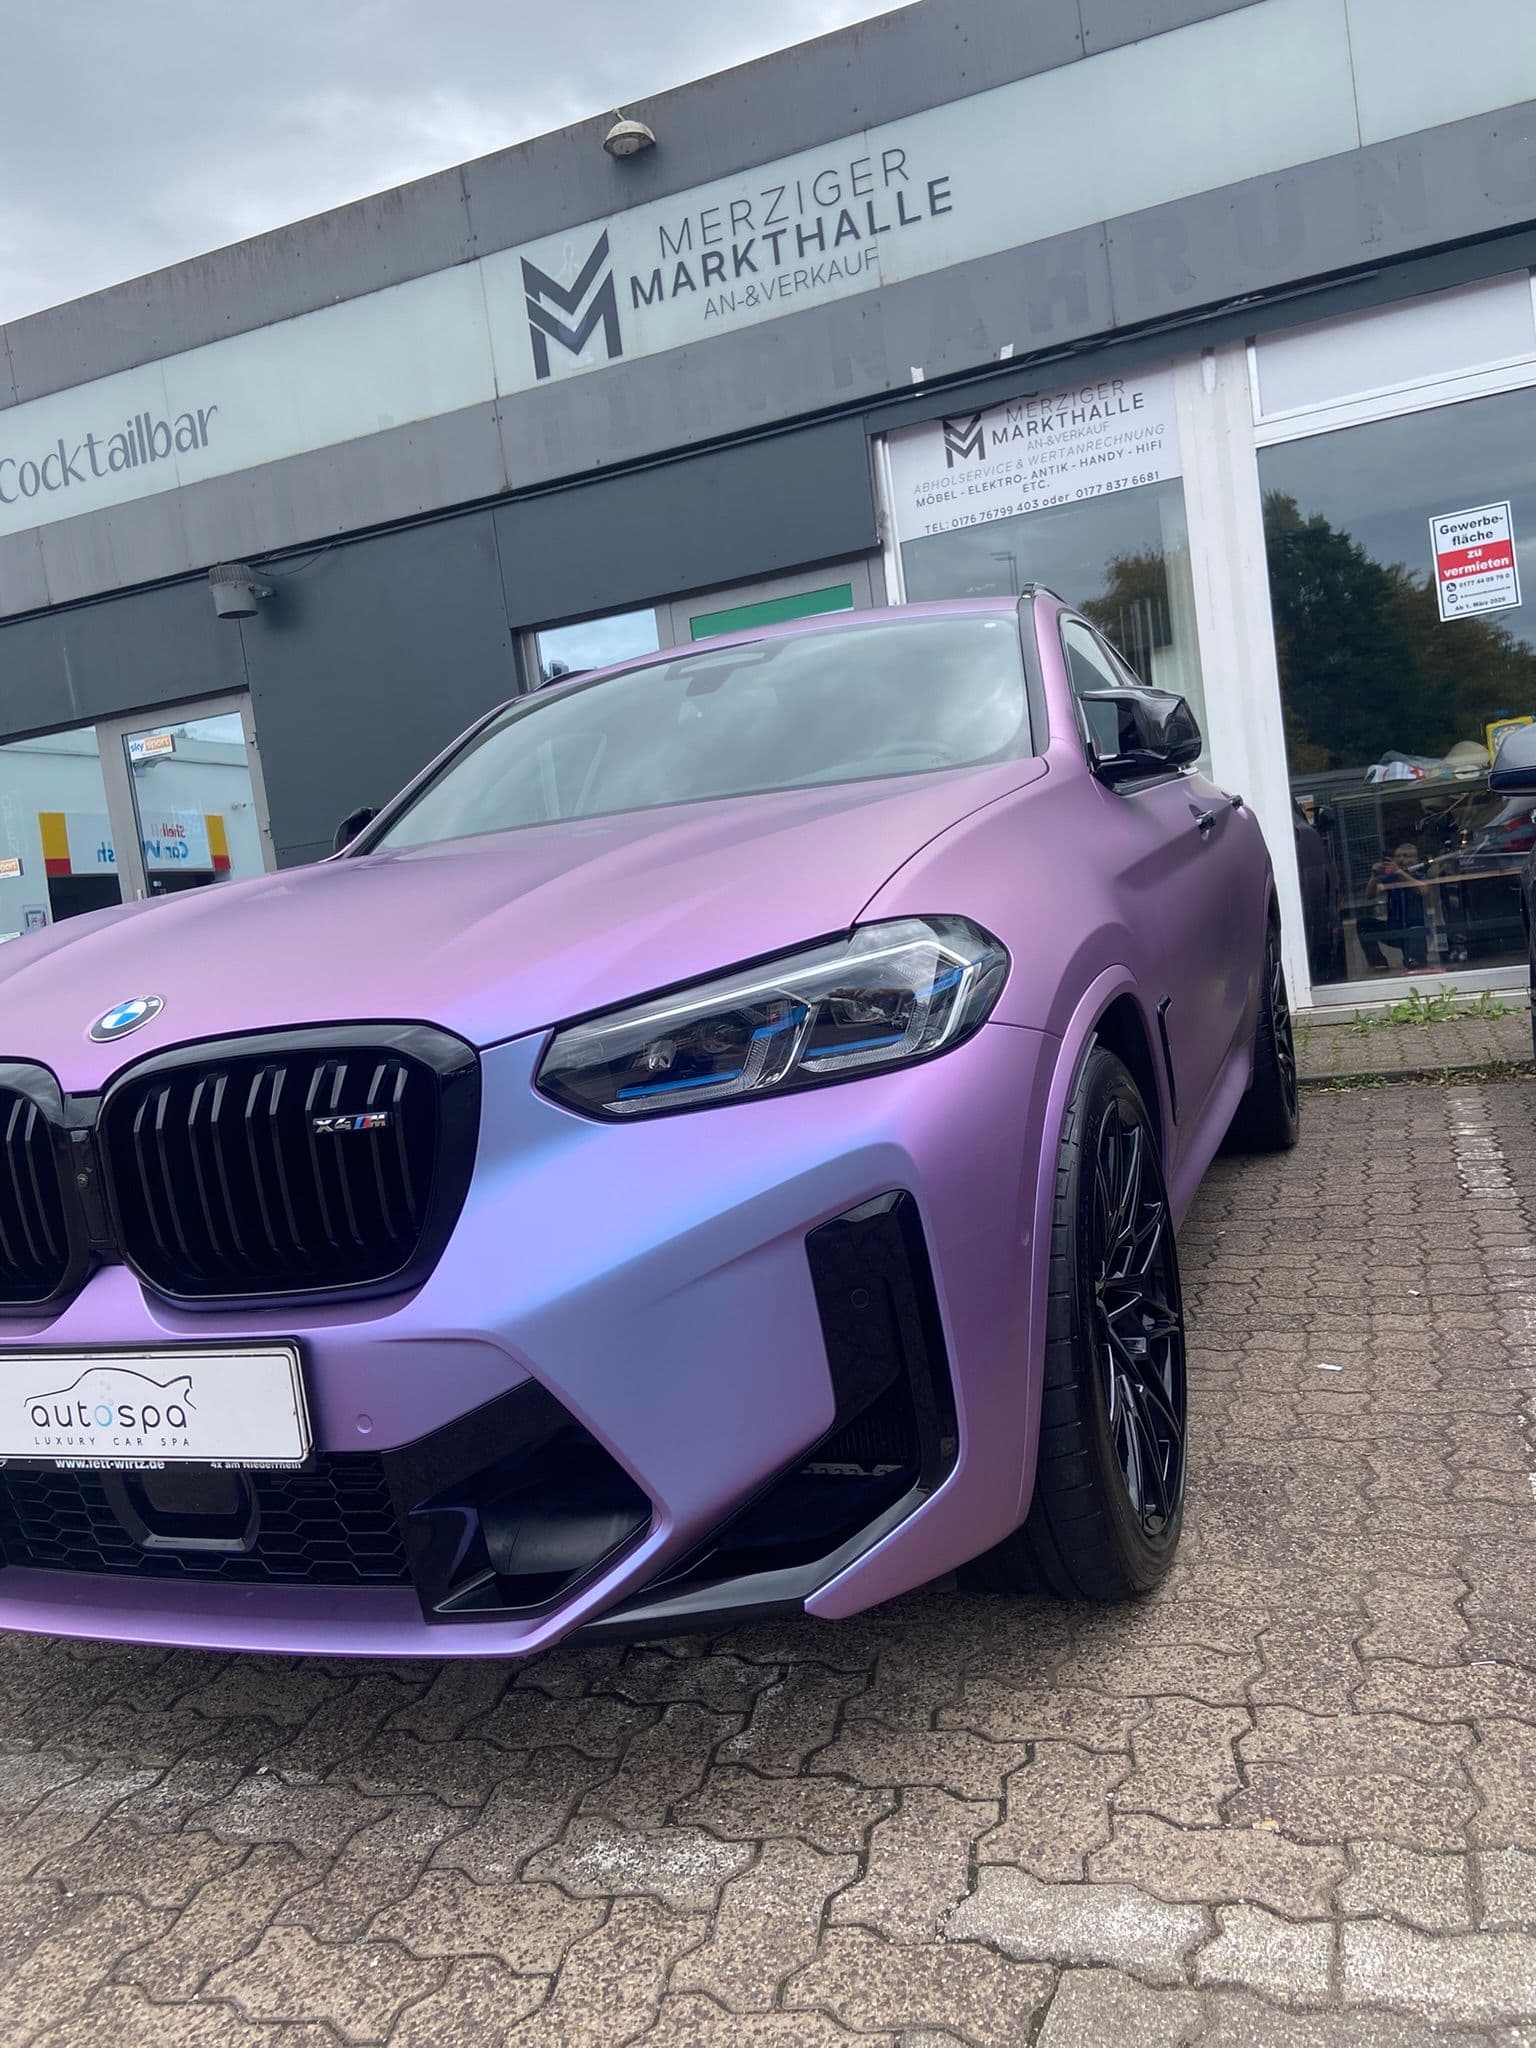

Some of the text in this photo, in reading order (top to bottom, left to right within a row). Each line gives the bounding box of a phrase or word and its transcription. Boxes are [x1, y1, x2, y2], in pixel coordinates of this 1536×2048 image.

[658, 148, 909, 259] MERZIGER
[629, 176, 953, 308] MARKTHALLE
[704, 246, 879, 320] AN-&VERKAUF
[992, 392, 1145, 445] MARKTHALLE
[1006, 379, 1125, 424] MERZIGER
[0, 404, 218, 504] Cocktailbar
[1026, 421, 1111, 451] AN-&VERKAUF
[913, 423, 1165, 496] ABHOLSERVICE & WERTANRECHNUNG
[916, 491, 958, 508] MÖBEL
[1031, 462, 1069, 480] ANTIK
[1079, 449, 1124, 468] HANDY
[1136, 439, 1162, 455] HIFI
[925, 471, 1160, 534] TEL: 0176 76799 403 oder 0177 837 6681
[1022, 479, 1050, 494] ETC.
[1440, 516, 1503, 534] Gewerbe-
[1452, 530, 1494, 546] fläche
[1444, 557, 1509, 577] vermieten
[1467, 548, 1482, 558] zu
[130, 741, 145, 754] sky
[31, 1401, 188, 1434] autospa
[34, 1436, 190, 1447] LUXURY CAR SPA
